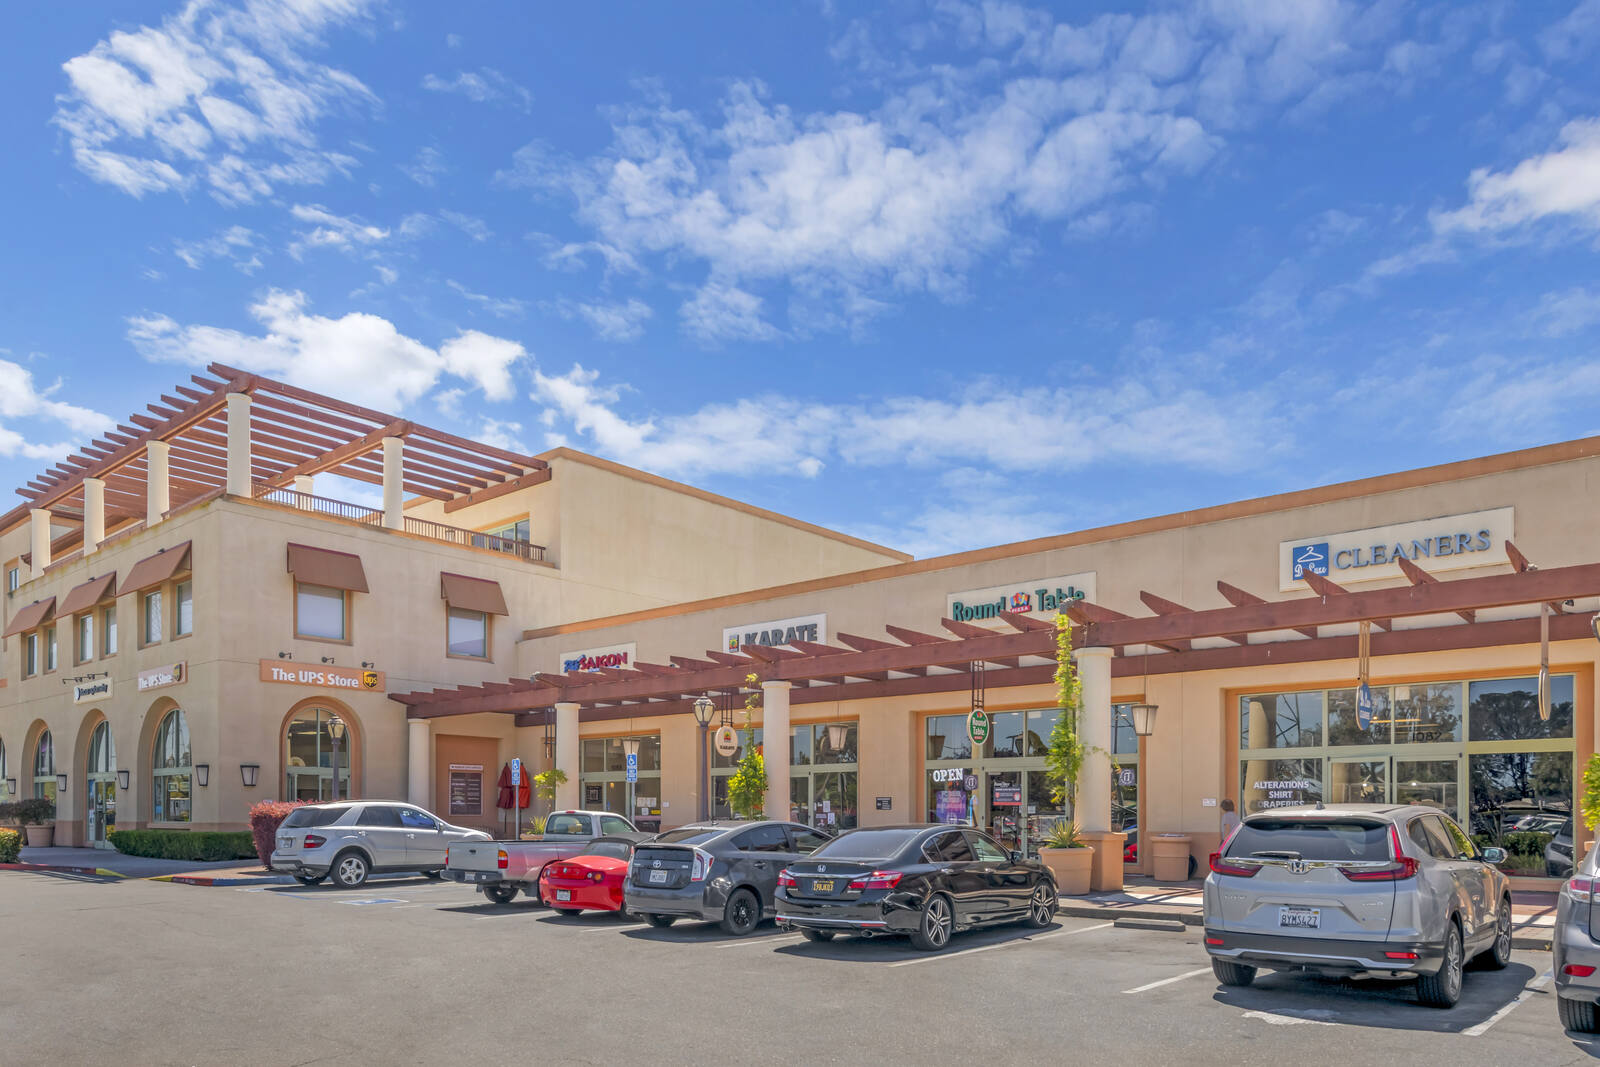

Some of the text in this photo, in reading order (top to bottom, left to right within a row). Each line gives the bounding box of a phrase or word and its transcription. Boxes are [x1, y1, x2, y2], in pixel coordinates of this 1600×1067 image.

[1333, 529, 1491, 570] CLEANERS
[953, 596, 1006, 621] Round
[745, 624, 817, 647] KARATE
[580, 652, 628, 670] SAIGON
[272, 668, 359, 688] The UPS Store
[933, 768, 964, 782] OPEN
[1254, 780, 1310, 789] ALTERATIONS
[1268, 790, 1293, 799] SHIRT
[1281, 914, 1317, 926] 8YMS427
